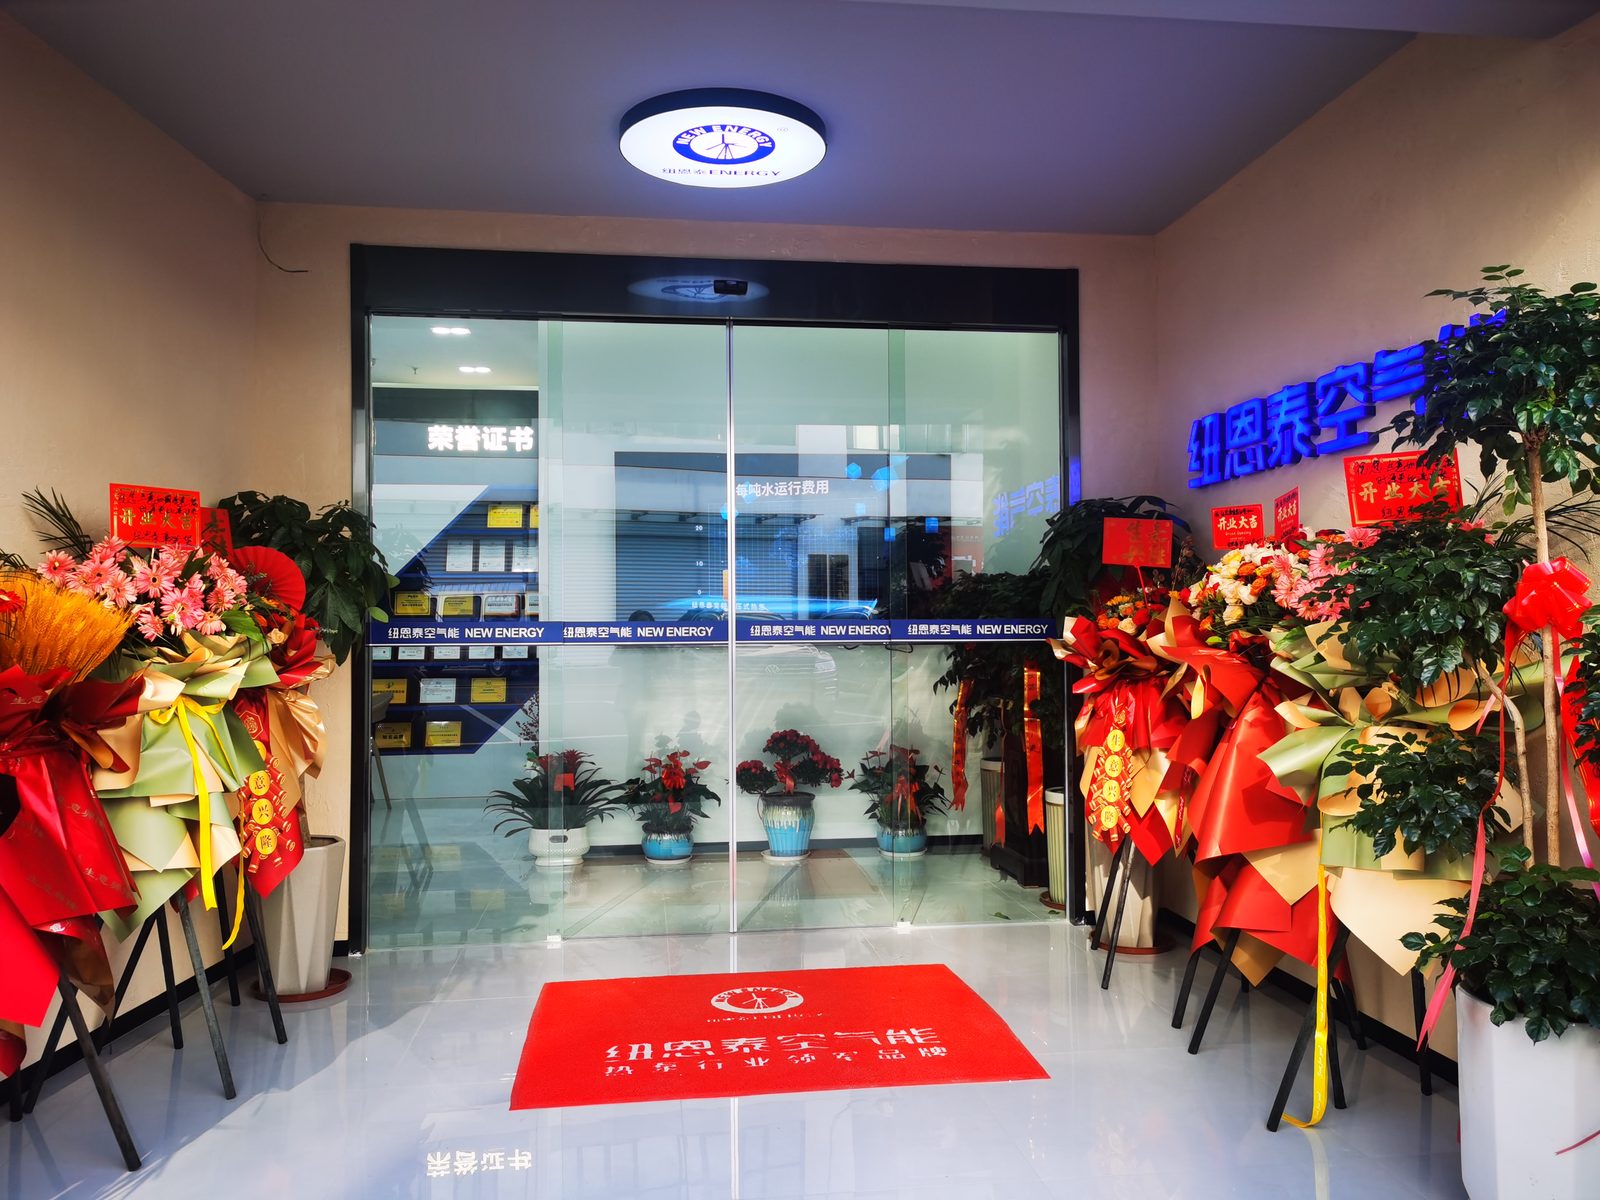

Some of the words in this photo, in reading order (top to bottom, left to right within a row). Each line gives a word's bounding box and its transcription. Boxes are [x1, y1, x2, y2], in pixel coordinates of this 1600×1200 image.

[676, 126, 707, 145] NEW
[711, 125, 773, 148] ENERGY
[427, 424, 534, 452] 荣誉证书
[735, 480, 829, 498] 每吨水运行费用
[1358, 477, 1451, 504] 开业大吉
[120, 507, 192, 531] 开业大吉
[1217, 514, 1258, 531] 开业大吉
[388, 627, 460, 639] 纽恩泰空气能
[464, 627, 494, 638] NEW
[495, 627, 545, 638] ENERGY
[562, 626, 633, 638] 纽恩泰空气能
[637, 627, 665, 637] NEW
[666, 627, 714, 637] ENERGY
[749, 624, 817, 637] 纽恩泰空气能
[820, 625, 847, 636] NEW
[848, 625, 892, 636] ENERGY
[907, 624, 972, 635] 纽恩泰空气能
[976, 625, 1002, 635] NEW
[1003, 624, 1049, 635] ENERGY
[604, 1027, 941, 1063] 纽恩泰空气能
